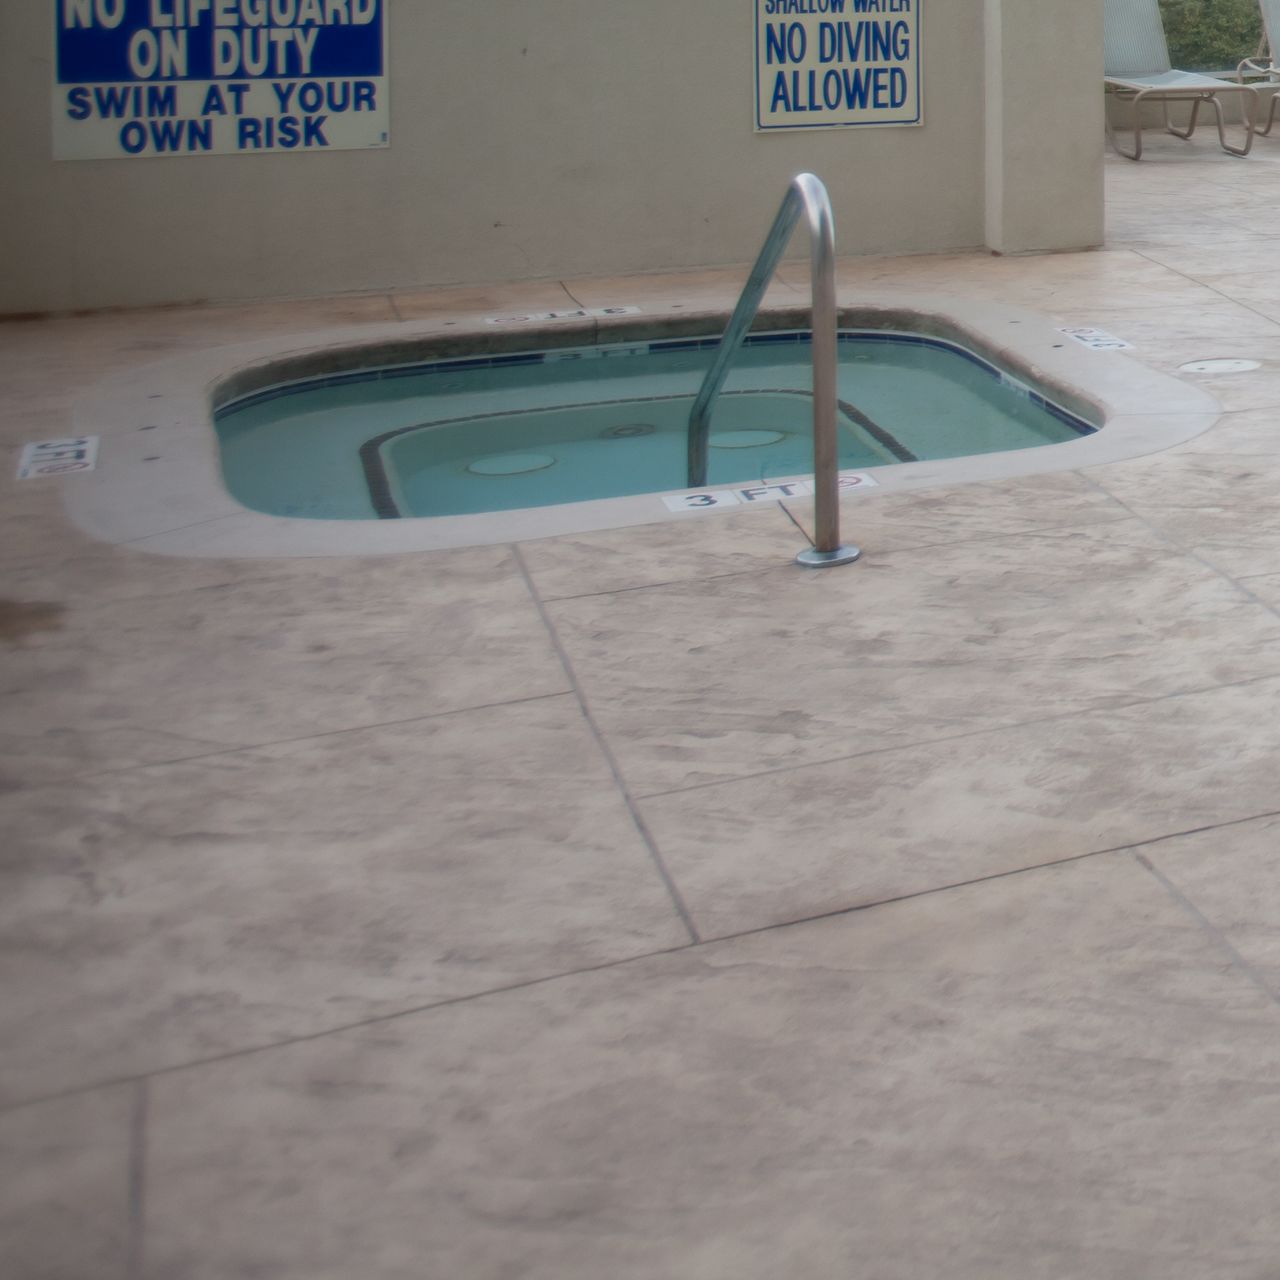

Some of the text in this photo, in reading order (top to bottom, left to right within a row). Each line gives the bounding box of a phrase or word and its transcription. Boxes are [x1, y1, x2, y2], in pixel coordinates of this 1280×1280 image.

[128, 27, 319, 78] ON DUTY
[766, 20, 910, 65] NO DIVING
[66, 80, 377, 120] SWIM AT YOUR
[770, 67, 908, 112] ALLOWED
[120, 115, 329, 154] OWN RISK
[684, 483, 797, 508] 3 FT
